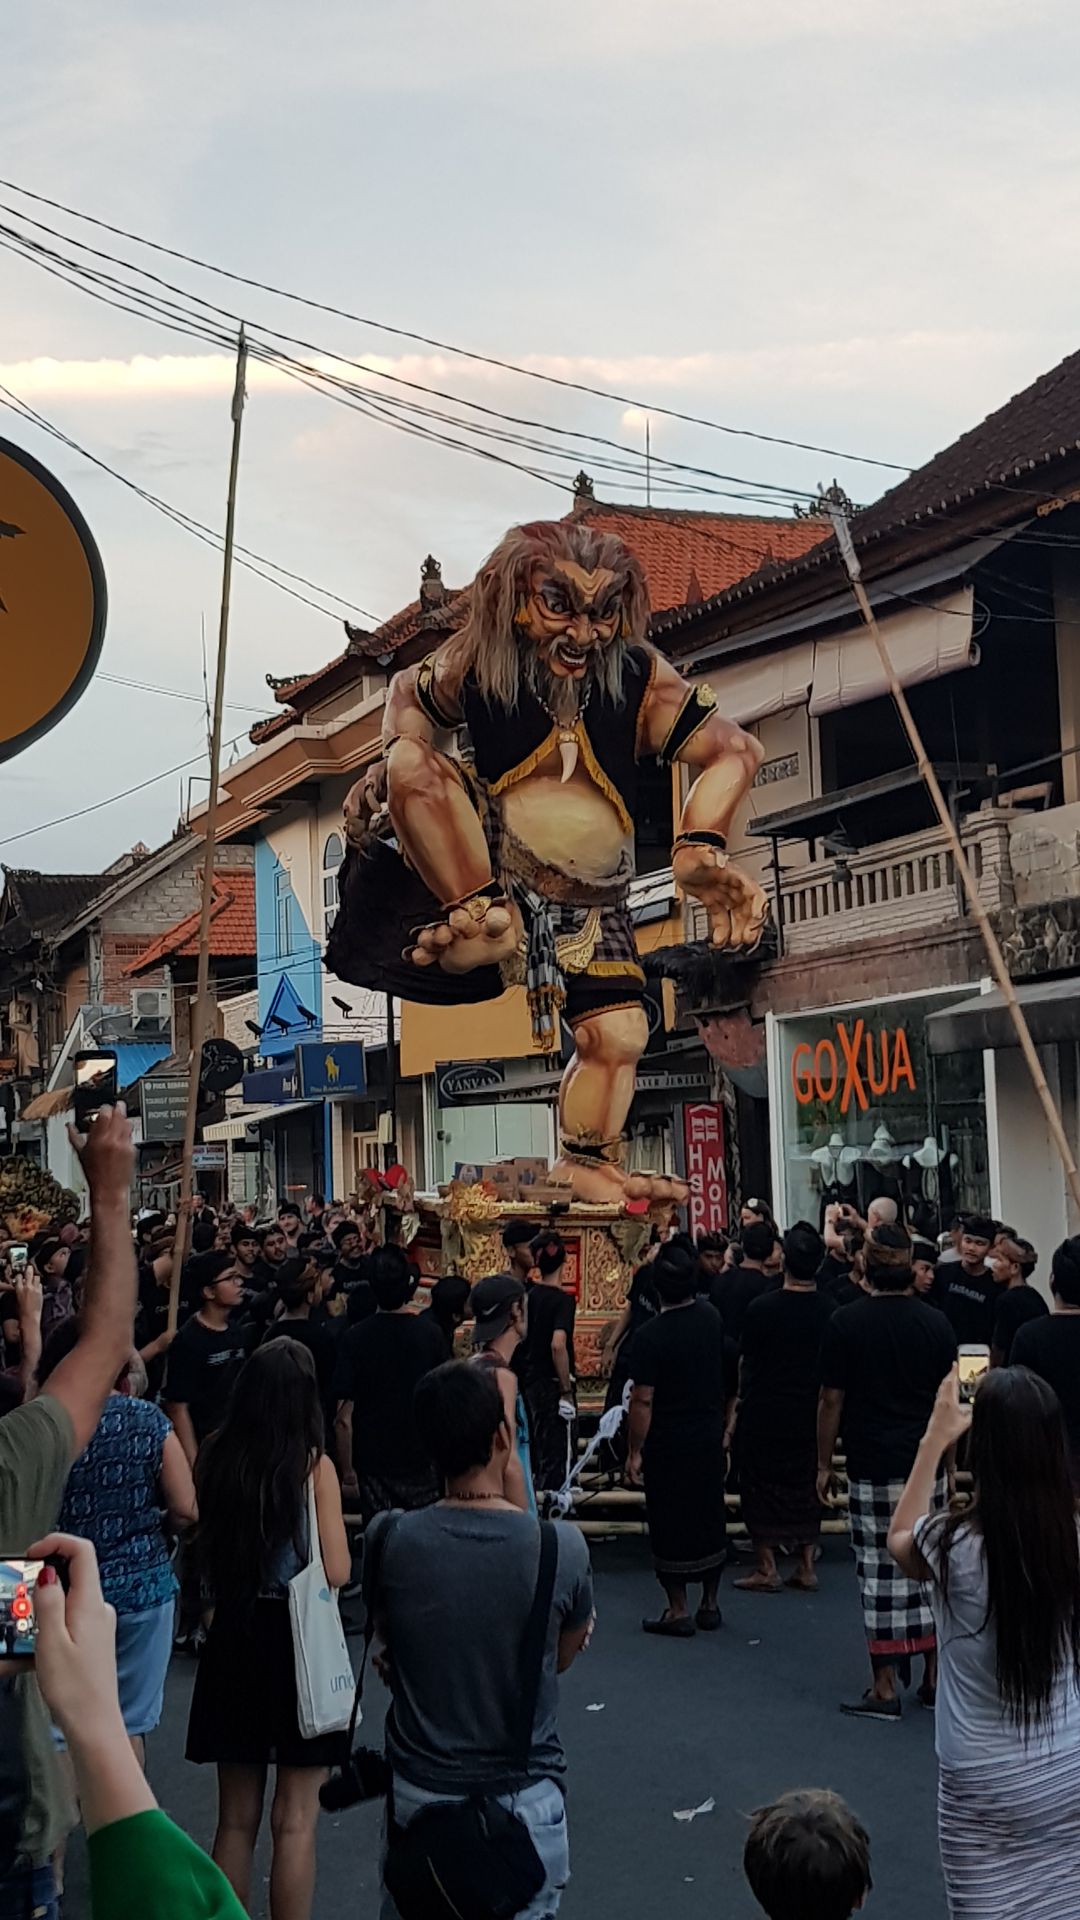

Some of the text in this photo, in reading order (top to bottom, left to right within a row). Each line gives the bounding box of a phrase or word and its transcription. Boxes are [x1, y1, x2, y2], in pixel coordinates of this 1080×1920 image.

[791, 1019, 916, 1114] GOXUA
[689, 1143, 707, 1245] Happ
[707, 1156, 726, 1232] Mon
[329, 1668, 354, 1694] unic
